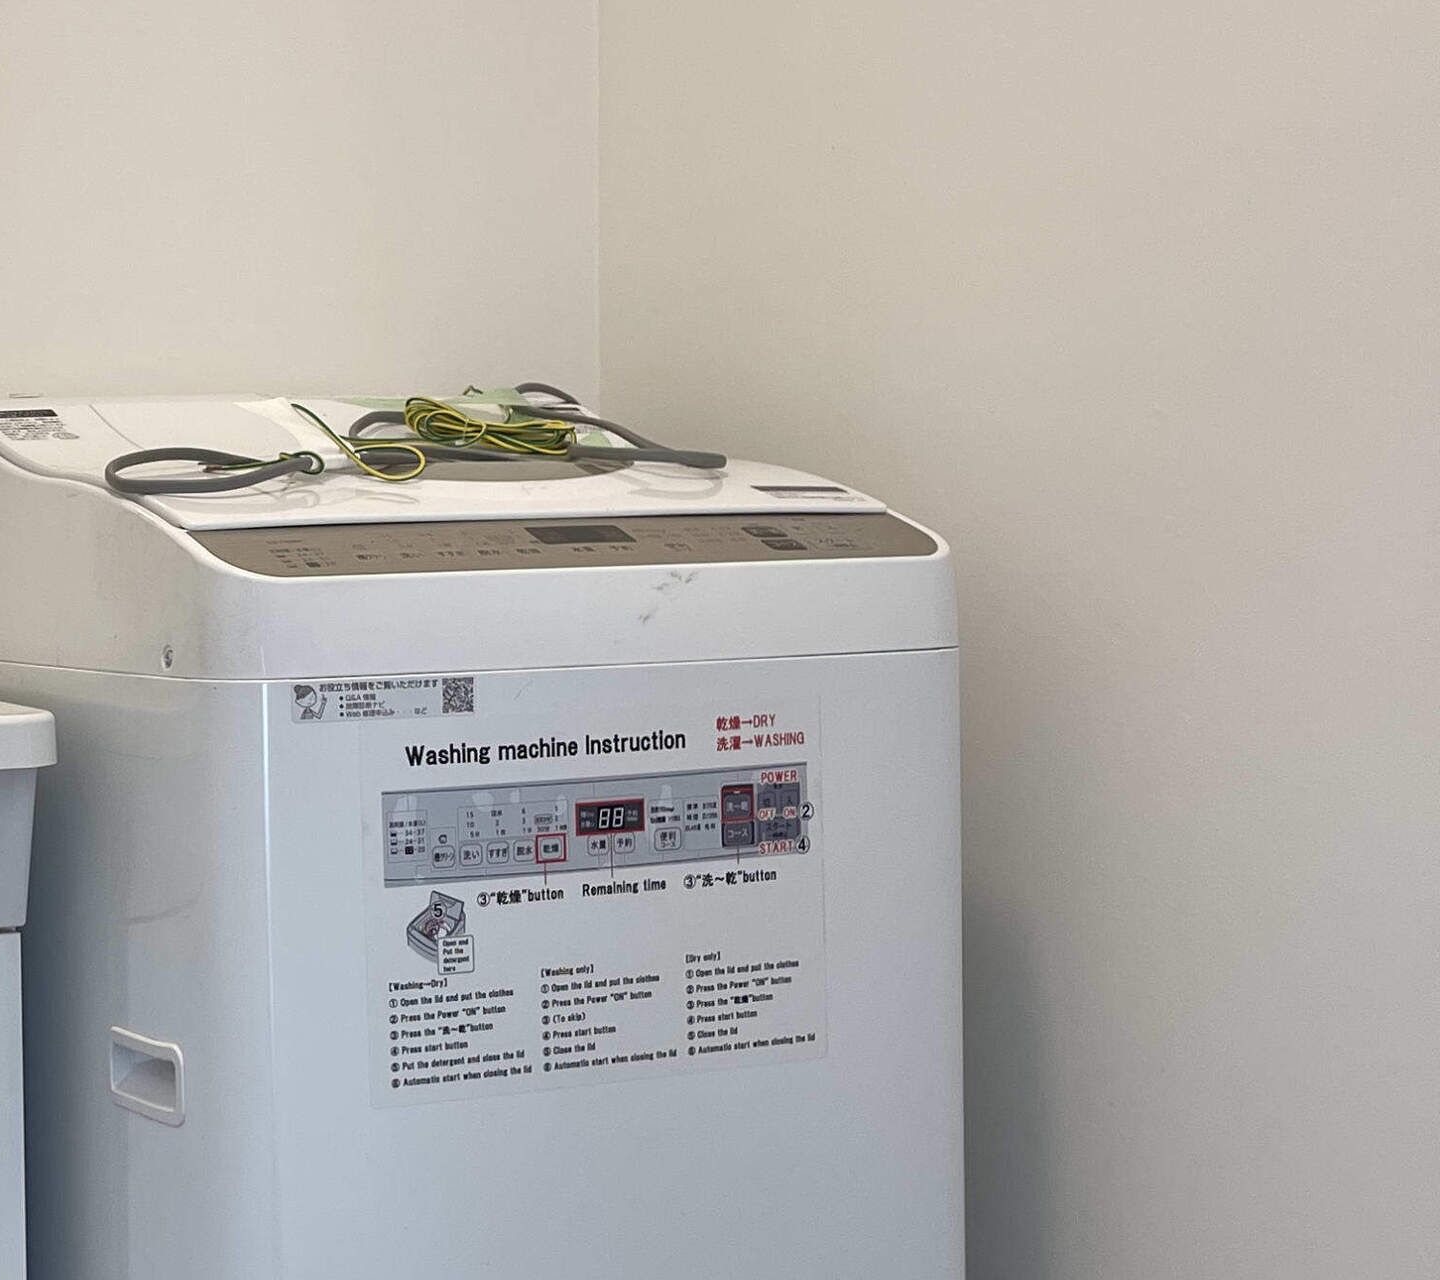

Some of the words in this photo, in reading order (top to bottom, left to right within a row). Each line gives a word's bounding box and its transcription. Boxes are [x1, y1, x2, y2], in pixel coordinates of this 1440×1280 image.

[753, 714, 776, 728] DRY
[754, 731, 804, 747] WASHING
[405, 744, 491, 767] Washing
[498, 733, 578, 760] machine
[585, 730, 686, 755] Instruction
[761, 770, 797, 783] POWER
[760, 809, 774, 819] OFF
[784, 807, 796, 817] ON
[760, 840, 793, 854] START
[582, 880, 639, 897] Remaining
[644, 878, 666, 890] time
[715, 967, 725, 975] the
[737, 965, 748, 973] and
[551, 983, 568, 992] Open
[571, 982, 582, 990] the
[595, 979, 607, 987] and
[623, 976, 633, 984] the
[400, 998, 418, 1006] Open
[421, 996, 432, 1004] the
[446, 994, 458, 1002] and
[475, 991, 486, 999] the
[489, 989, 513, 998] clothes
[552, 999, 571, 1007] Press
[574, 997, 584, 1005] the
[587, 995, 607, 1004] Power
[630, 991, 652, 999] button
[400, 1014, 420, 1023] Press
[424, 1012, 435, 1020] the
[437, 1010, 459, 1019] Power
[483, 1006, 506, 1015] button
[401, 1030, 421, 1039] Press
[424, 1028, 435, 1036] the
[553, 1030, 572, 1038] Press
[575, 1028, 591, 1036] start
[594, 1026, 616, 1034] button
[730, 1027, 738, 1035] lid
[402, 1046, 421, 1054] Press
[425, 1044, 442, 1052] start
[445, 1042, 468, 1050] button
[553, 1046, 572, 1054] Close
[574, 1044, 585, 1052] the
[587, 1042, 595, 1050] lid
[402, 1062, 414, 1070] Put
[417, 1060, 429, 1068] the
[468, 1055, 480, 1064] and
[483, 1054, 500, 1062] close
[503, 1052, 514, 1060] the
[516, 1050, 524, 1058] lid
[554, 1059, 589, 1070] Automatic
[592, 1057, 608, 1065] start
[669, 1049, 677, 1057] lid
[403, 1075, 440, 1086] Automatic
[443, 1074, 460, 1082] start
[463, 1071, 481, 1080] when
[510, 1067, 521, 1075] the
[524, 1065, 532, 1073] lid
